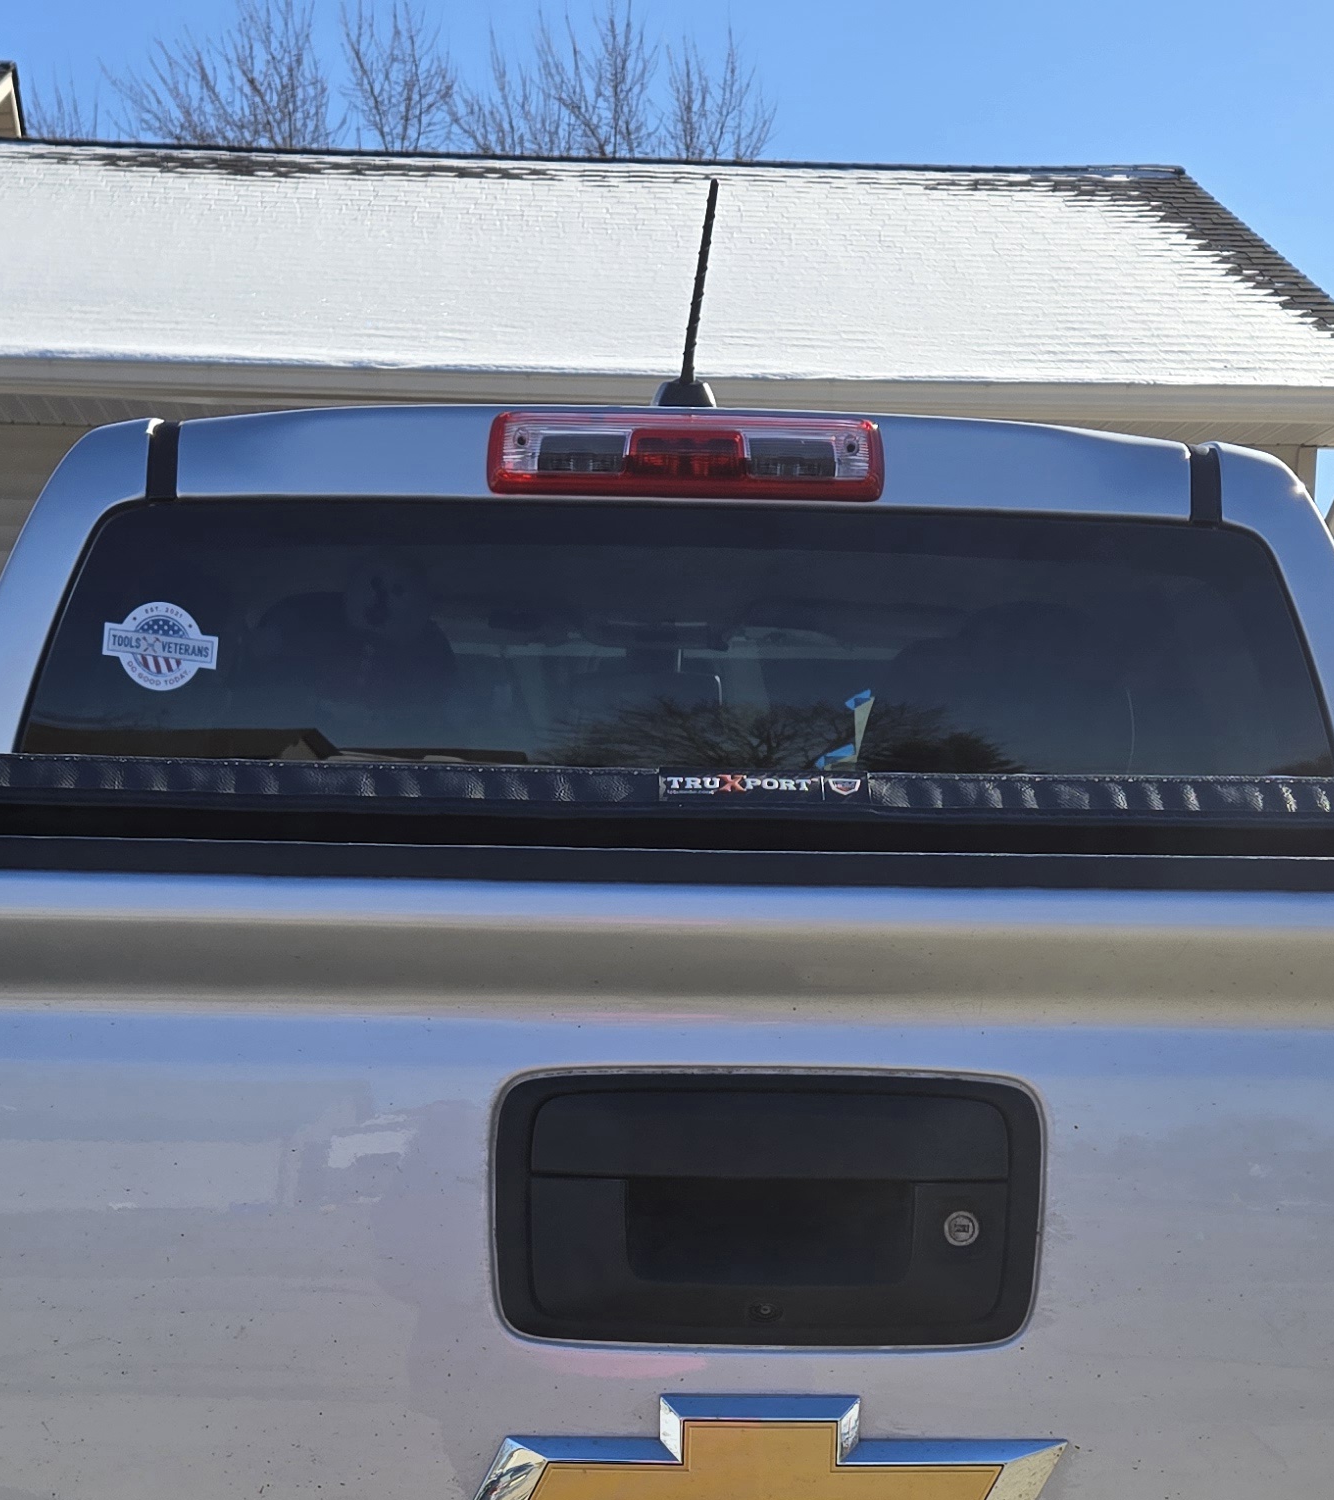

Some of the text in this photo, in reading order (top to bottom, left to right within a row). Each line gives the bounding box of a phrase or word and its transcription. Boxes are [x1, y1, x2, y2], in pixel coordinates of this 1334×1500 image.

[112, 634, 209, 658] TOOLS VETERANS
[127, 661, 137, 673] DO
[138, 673, 161, 686] GOOD
[667, 774, 812, 792] TRUXPORT
